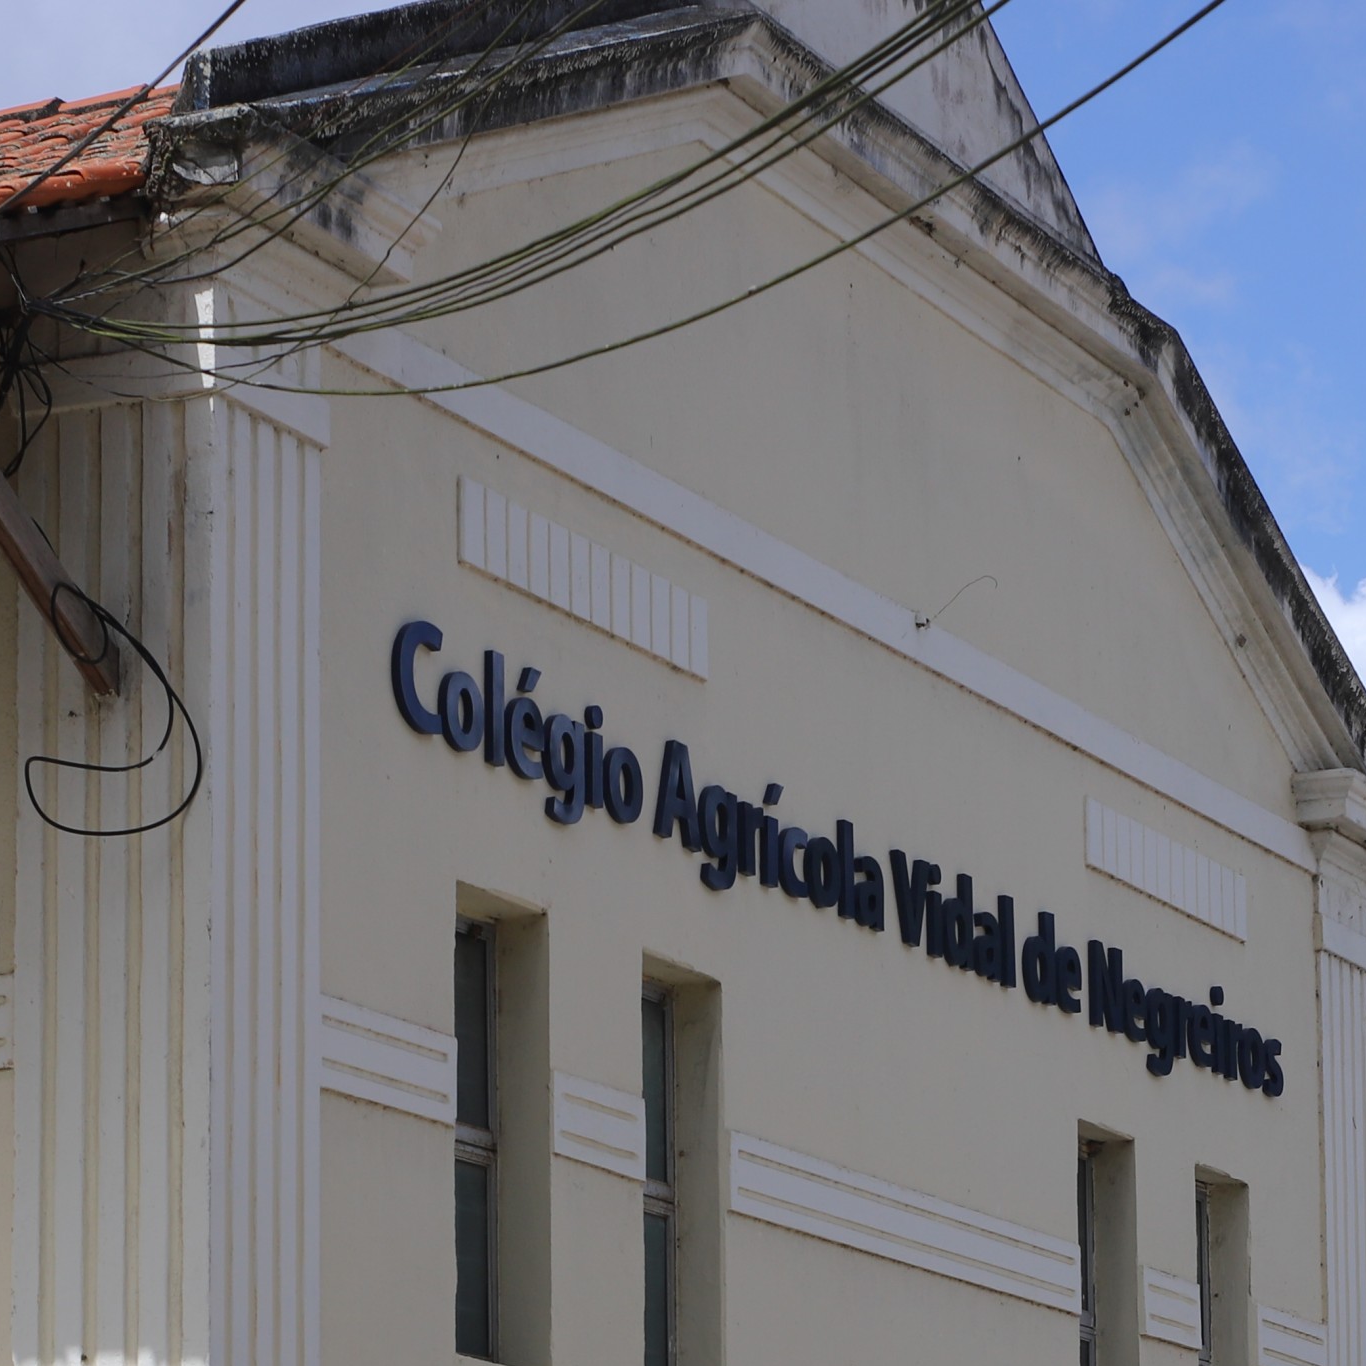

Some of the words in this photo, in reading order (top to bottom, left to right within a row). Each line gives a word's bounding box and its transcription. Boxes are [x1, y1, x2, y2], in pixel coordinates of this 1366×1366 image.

[391, 620, 643, 824] Colégio
[653, 739, 885, 932] Agrícola
[889, 849, 1016, 988] Vidal
[1022, 911, 1082, 1013] de
[1088, 940, 1284, 1097] Negreiros
